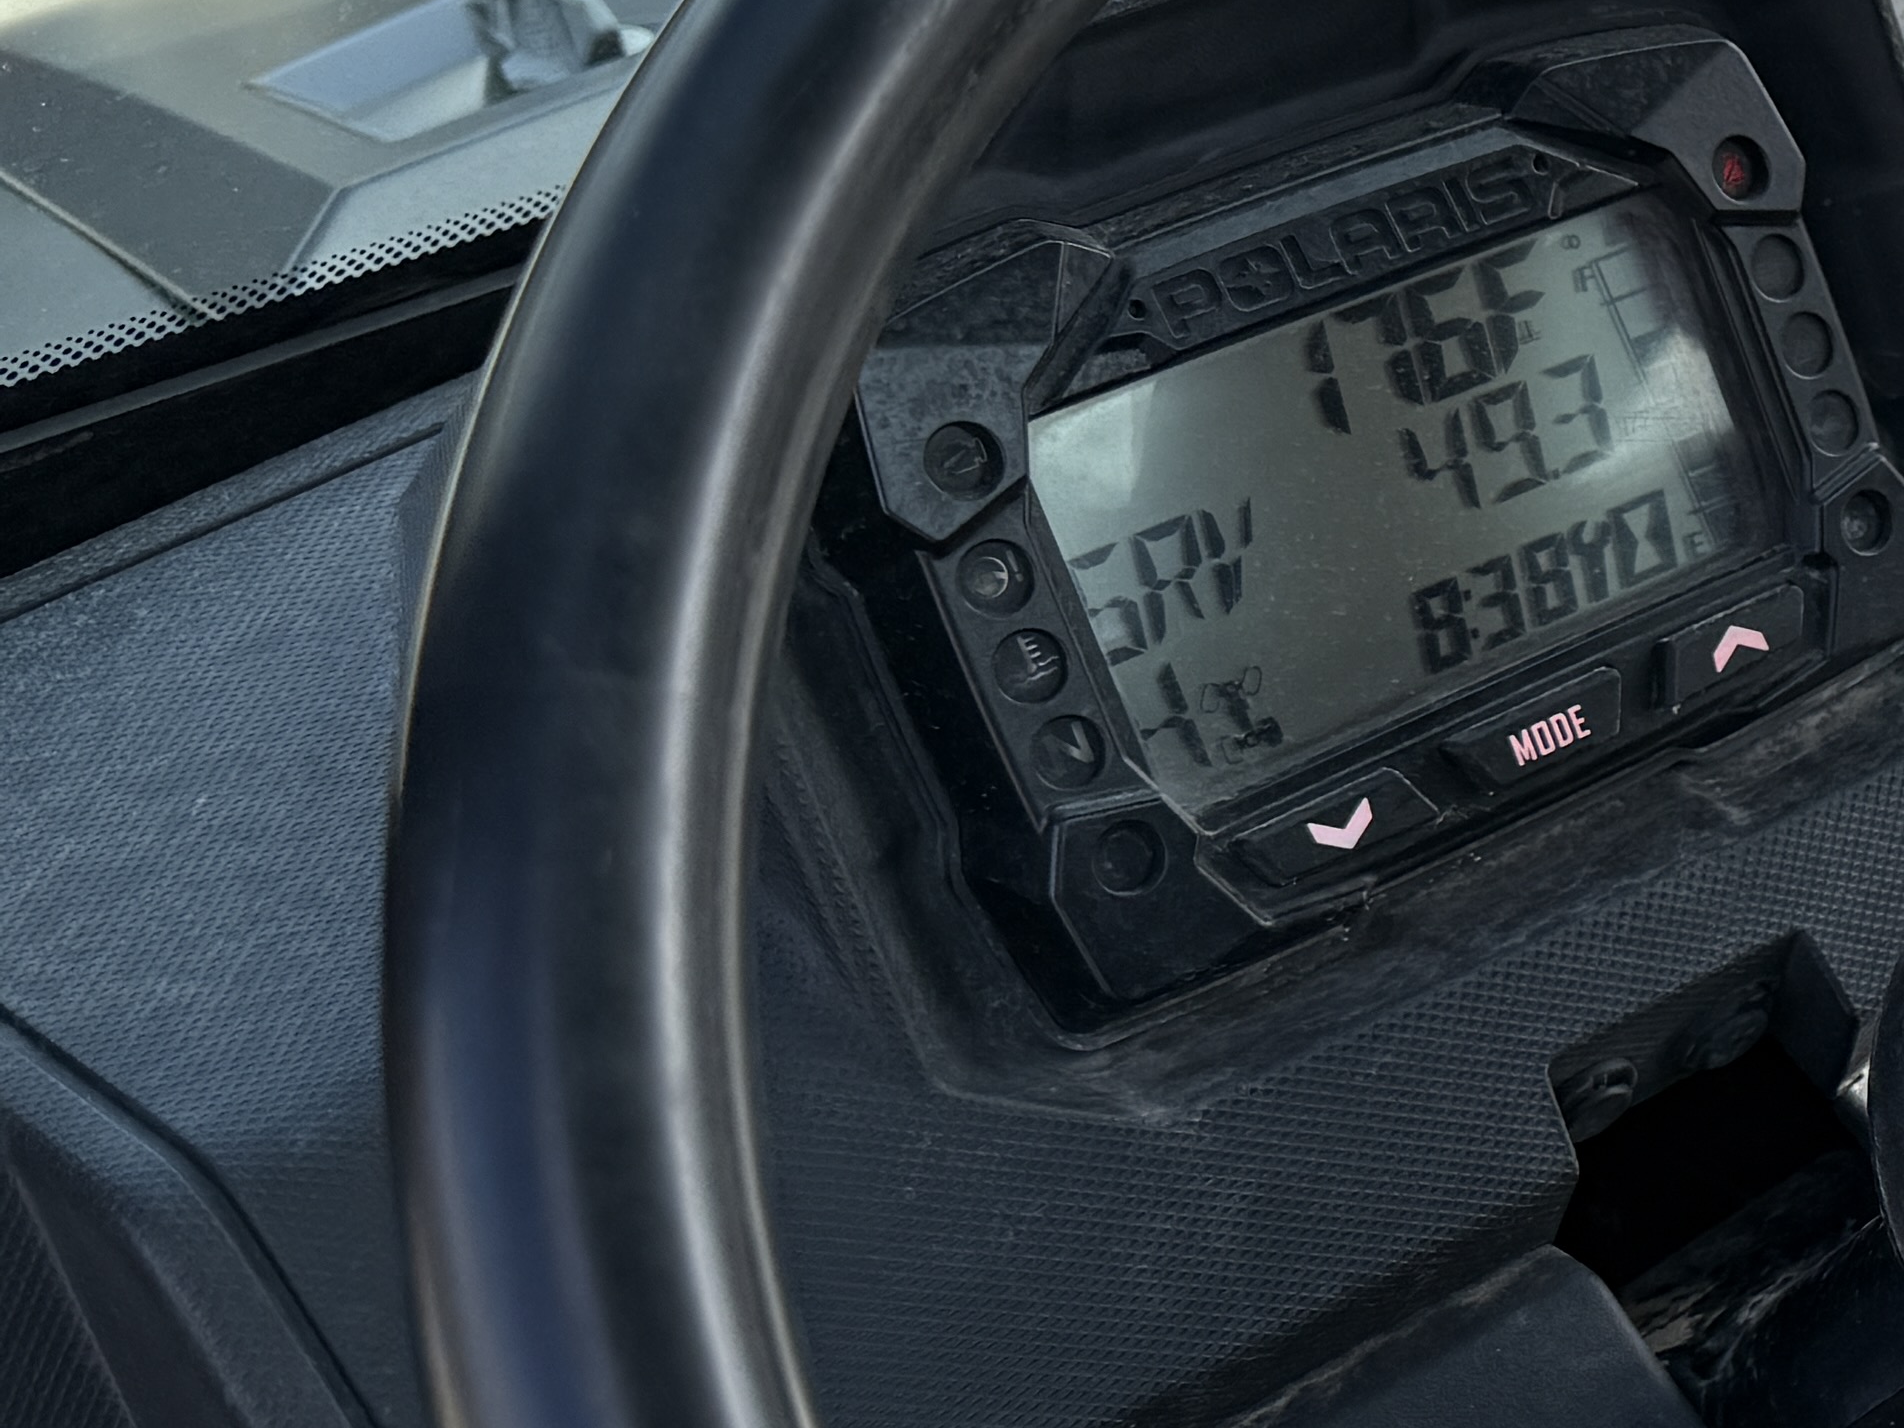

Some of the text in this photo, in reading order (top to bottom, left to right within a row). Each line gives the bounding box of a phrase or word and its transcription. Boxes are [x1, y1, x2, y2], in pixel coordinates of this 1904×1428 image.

[1150, 160, 1537, 340] POLARIS
[1304, 237, 1546, 436] 176F
[1398, 354, 1613, 509] 49.3
[1508, 704, 1592, 767] MODE
